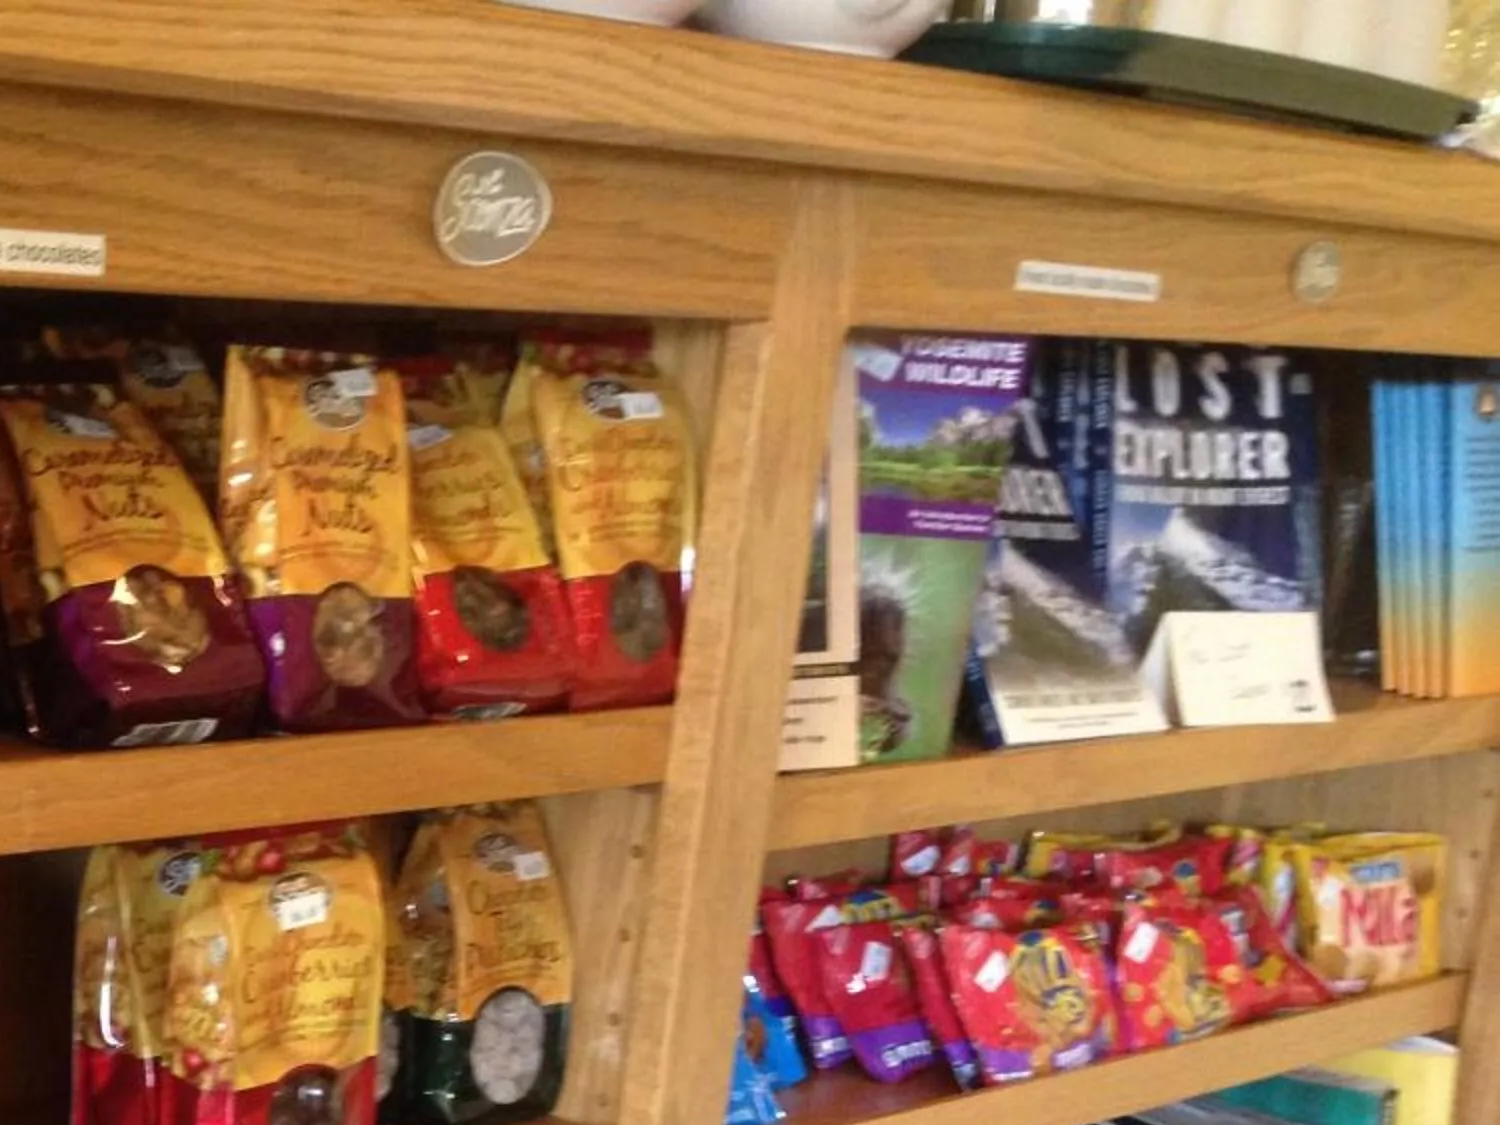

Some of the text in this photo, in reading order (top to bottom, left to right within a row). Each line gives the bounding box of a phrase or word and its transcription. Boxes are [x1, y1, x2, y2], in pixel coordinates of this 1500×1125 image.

[905, 361, 1021, 390] WILDLIFE
[1113, 345, 1289, 420] LOST
[1112, 418, 1291, 480] EXPLORER
